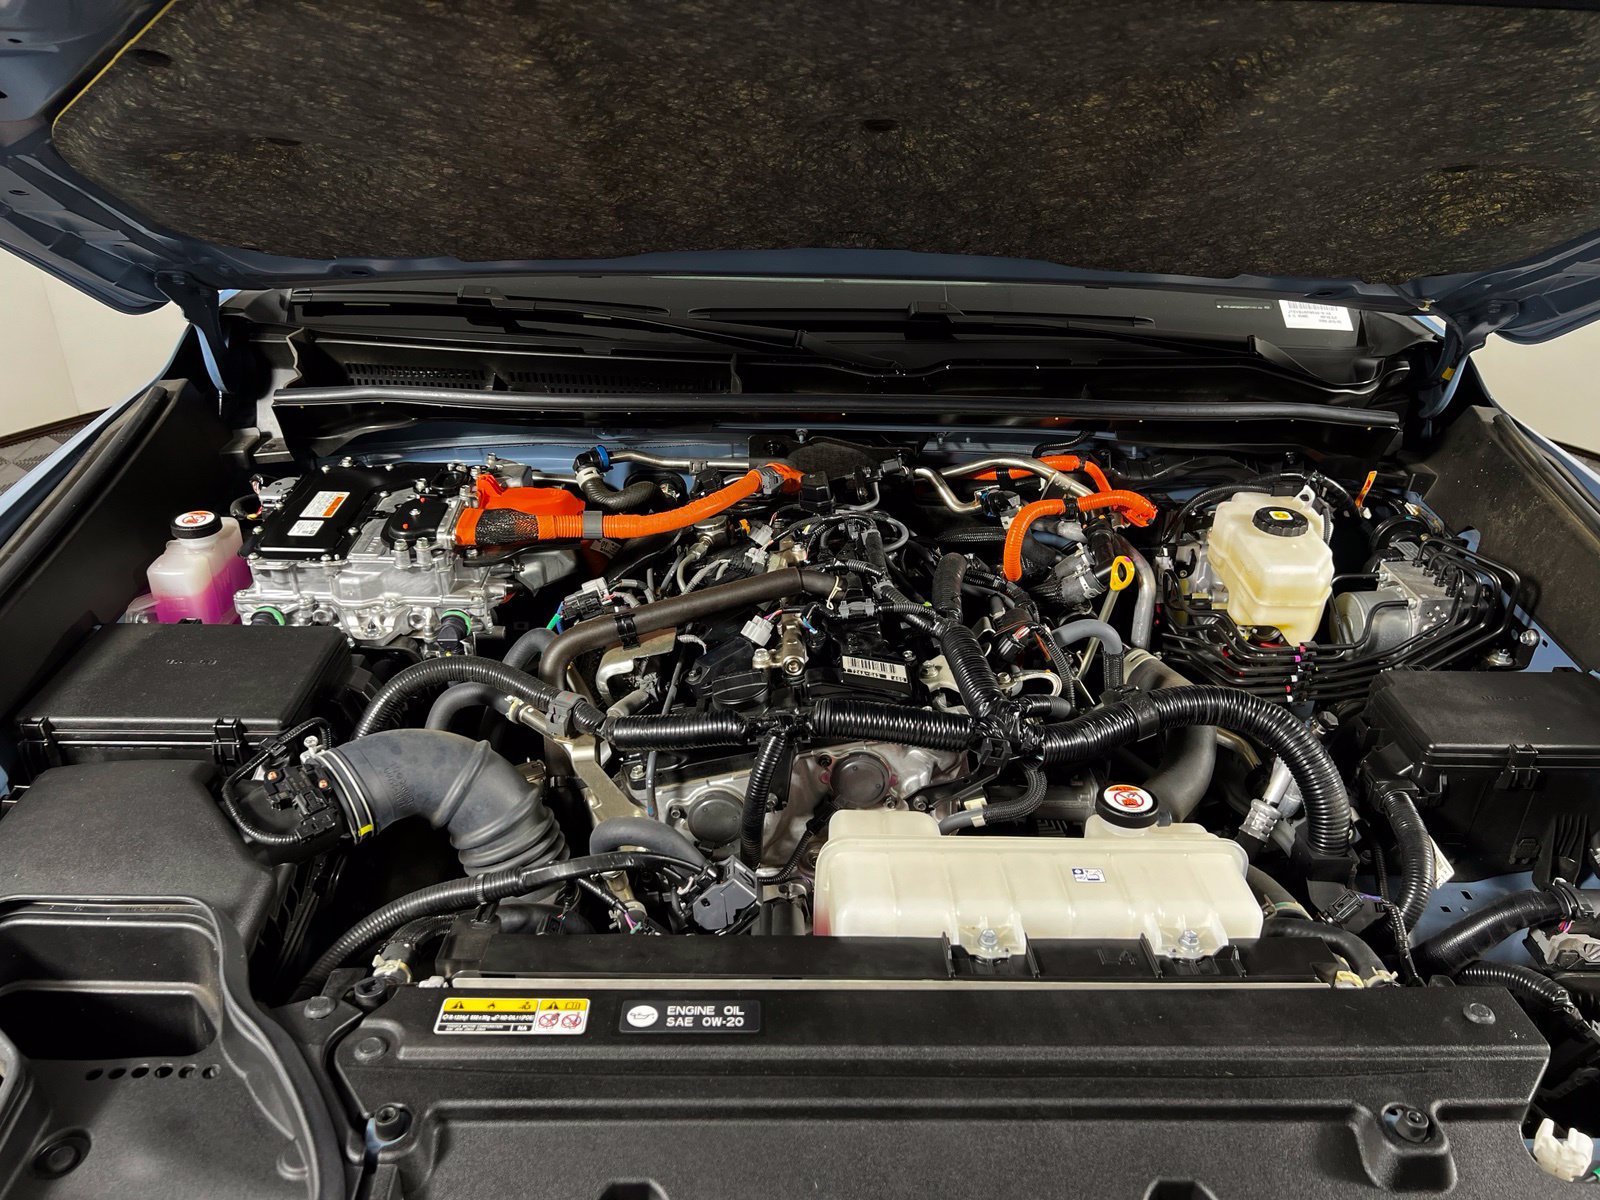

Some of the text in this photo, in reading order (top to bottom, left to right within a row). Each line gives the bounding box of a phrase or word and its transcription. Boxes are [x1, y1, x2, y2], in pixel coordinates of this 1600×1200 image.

[667, 1005, 745, 1016] ENGINE OIL
[665, 1016, 744, 1027] SAE 0W-20
